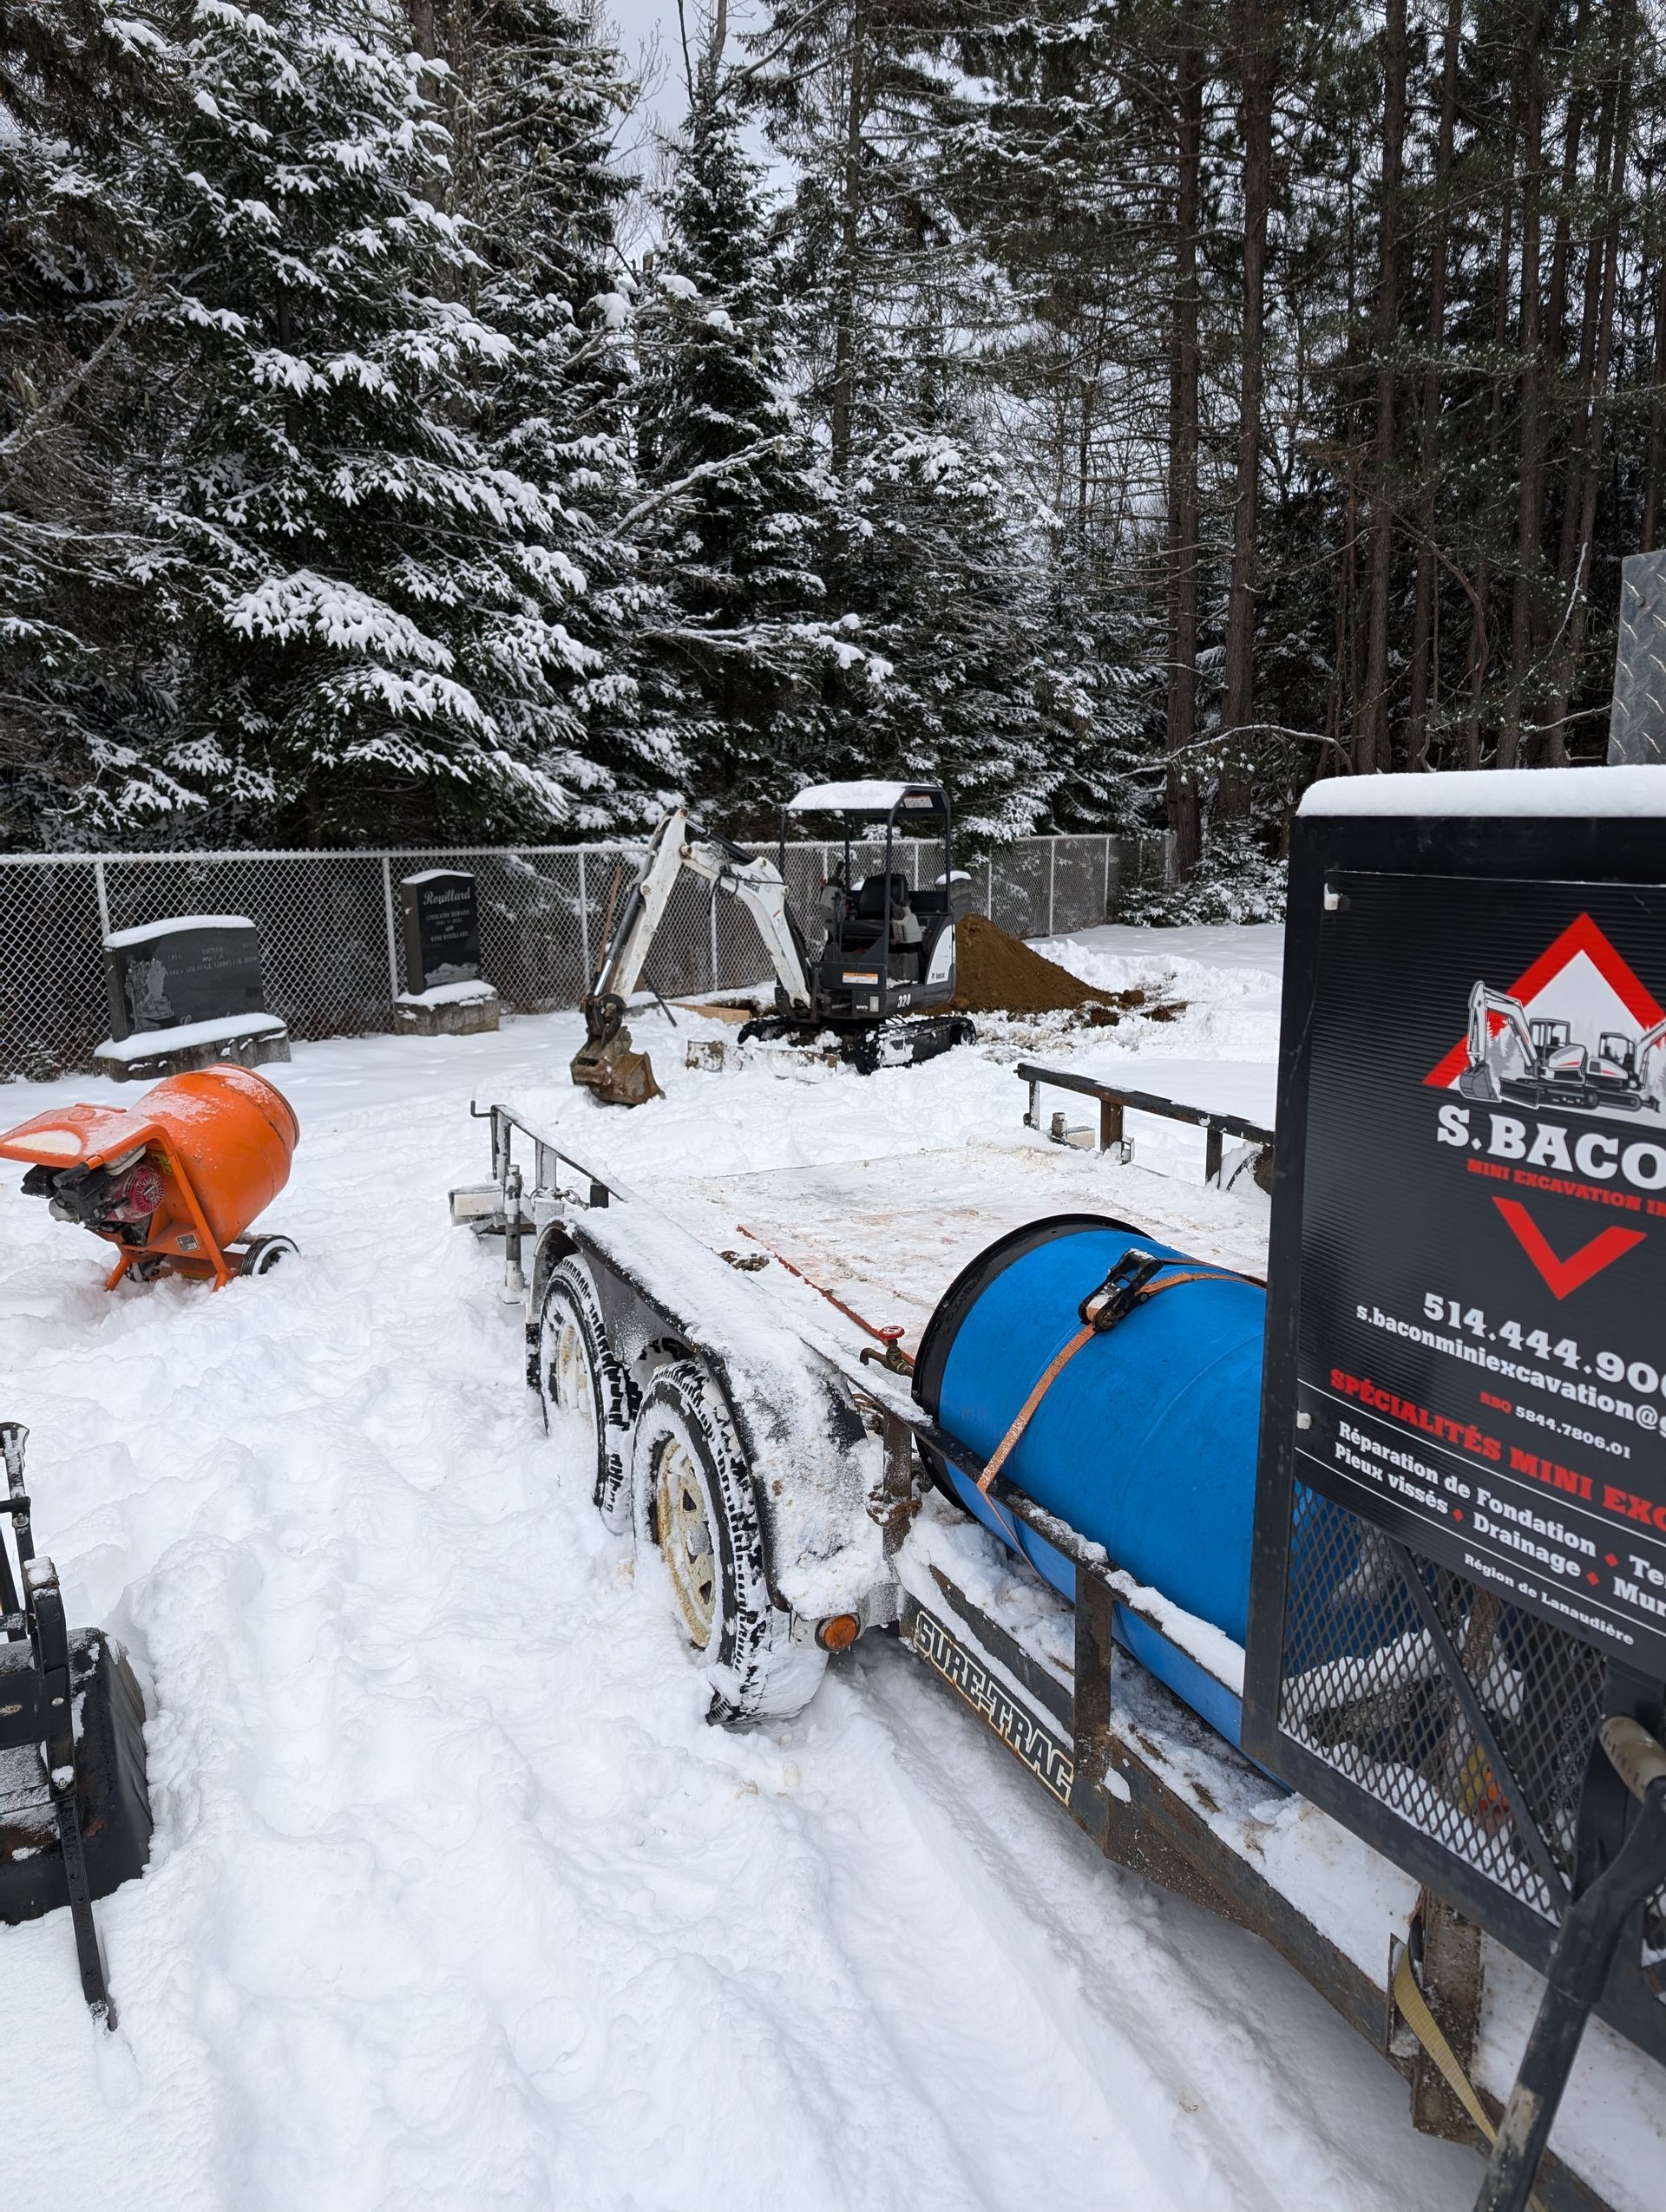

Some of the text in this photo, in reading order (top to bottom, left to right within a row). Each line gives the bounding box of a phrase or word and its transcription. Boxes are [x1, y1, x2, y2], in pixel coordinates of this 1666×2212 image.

[423, 887, 470, 905] Rouillard
[896, 992, 911, 1008] 324
[1466, 1158, 1510, 1180] MINI
[1513, 1169, 1643, 1212] EXCAVATION
[1330, 1368, 1502, 1461] SPÉCIALITÉS
[1509, 1446, 1593, 1502] MINI
[1479, 1391, 1631, 1460] RBQ 5844.7806.01
[1335, 1443, 1384, 1482] Pieux
[1388, 1473, 1449, 1515] vissés
[1473, 1511, 1582, 1578] Drainage
[1338, 1420, 1440, 1485] Réparation
[1444, 1474, 1471, 1500] de
[1476, 1486, 1597, 1558] Fondation
[1464, 1553, 1635, 1646] Région de Lanaudière
[914, 1611, 1075, 1807] SURE-TRAC
